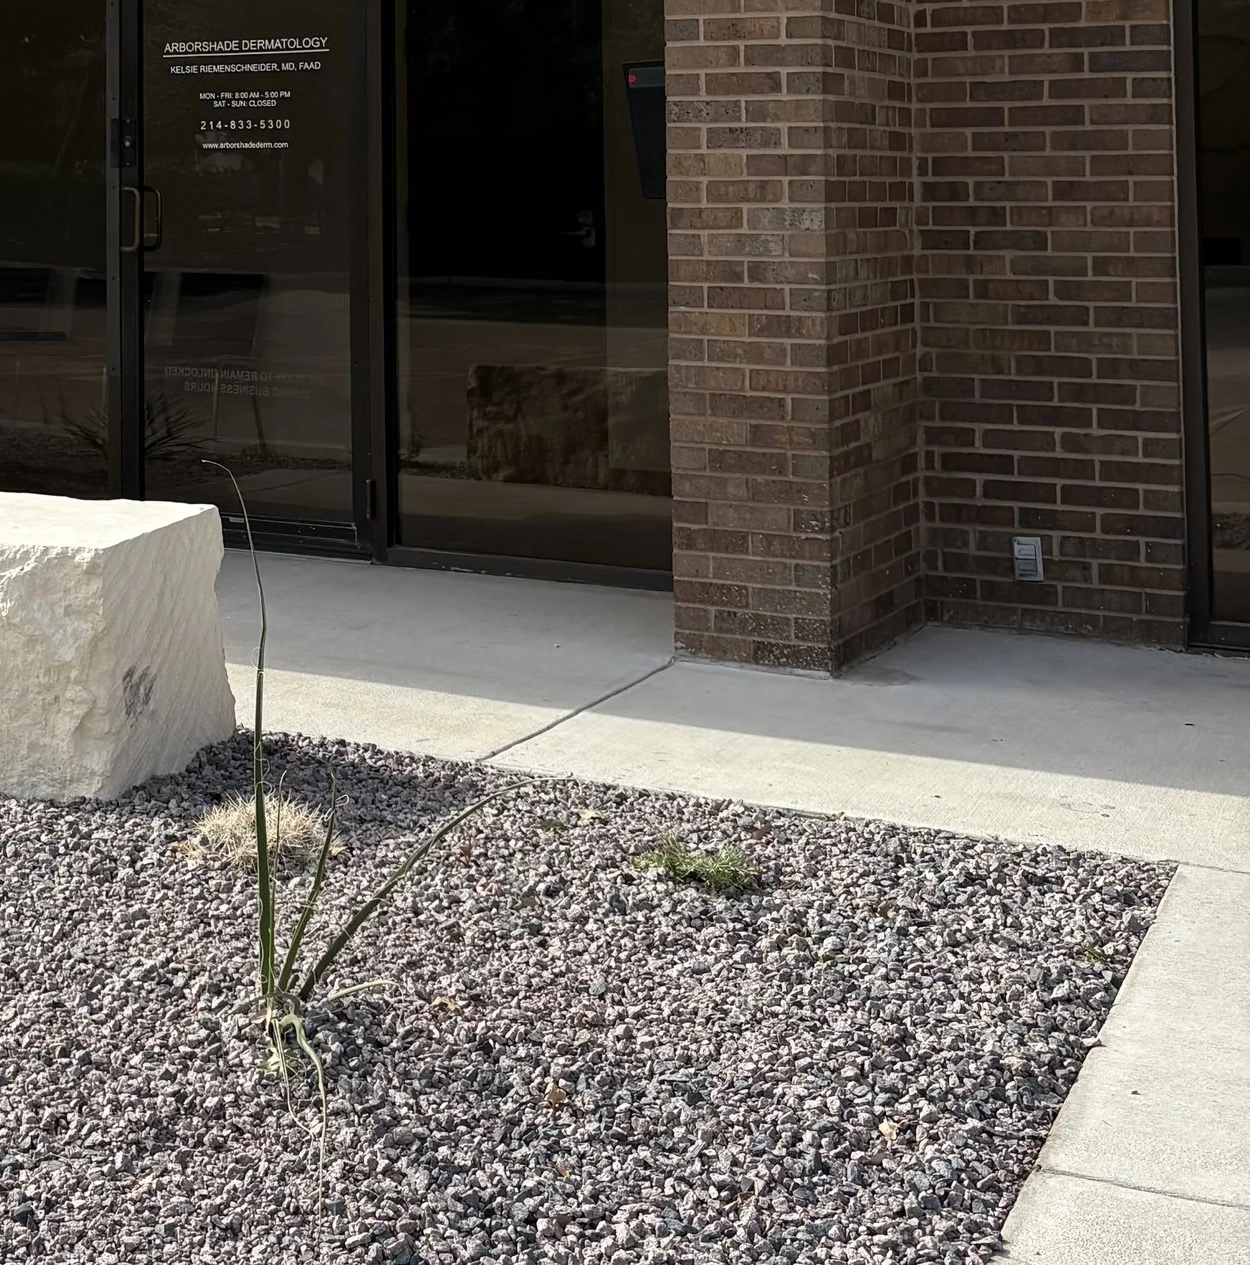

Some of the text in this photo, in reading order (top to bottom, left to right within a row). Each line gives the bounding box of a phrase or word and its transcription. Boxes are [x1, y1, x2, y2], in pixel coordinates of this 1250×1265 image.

[163, 37, 328, 53] ARBORSHADE DERMATOLOGY
[170, 61, 321, 74] KELSIE RIEMENSCHNEIDER, MD, FAAD
[199, 92, 216, 100] MON
[213, 100, 226, 108] SAT
[248, 99, 277, 107] CLOSED
[200, 119, 290, 130] 214-833-5300
[202, 141, 289, 149] www.arborshadederm.com
